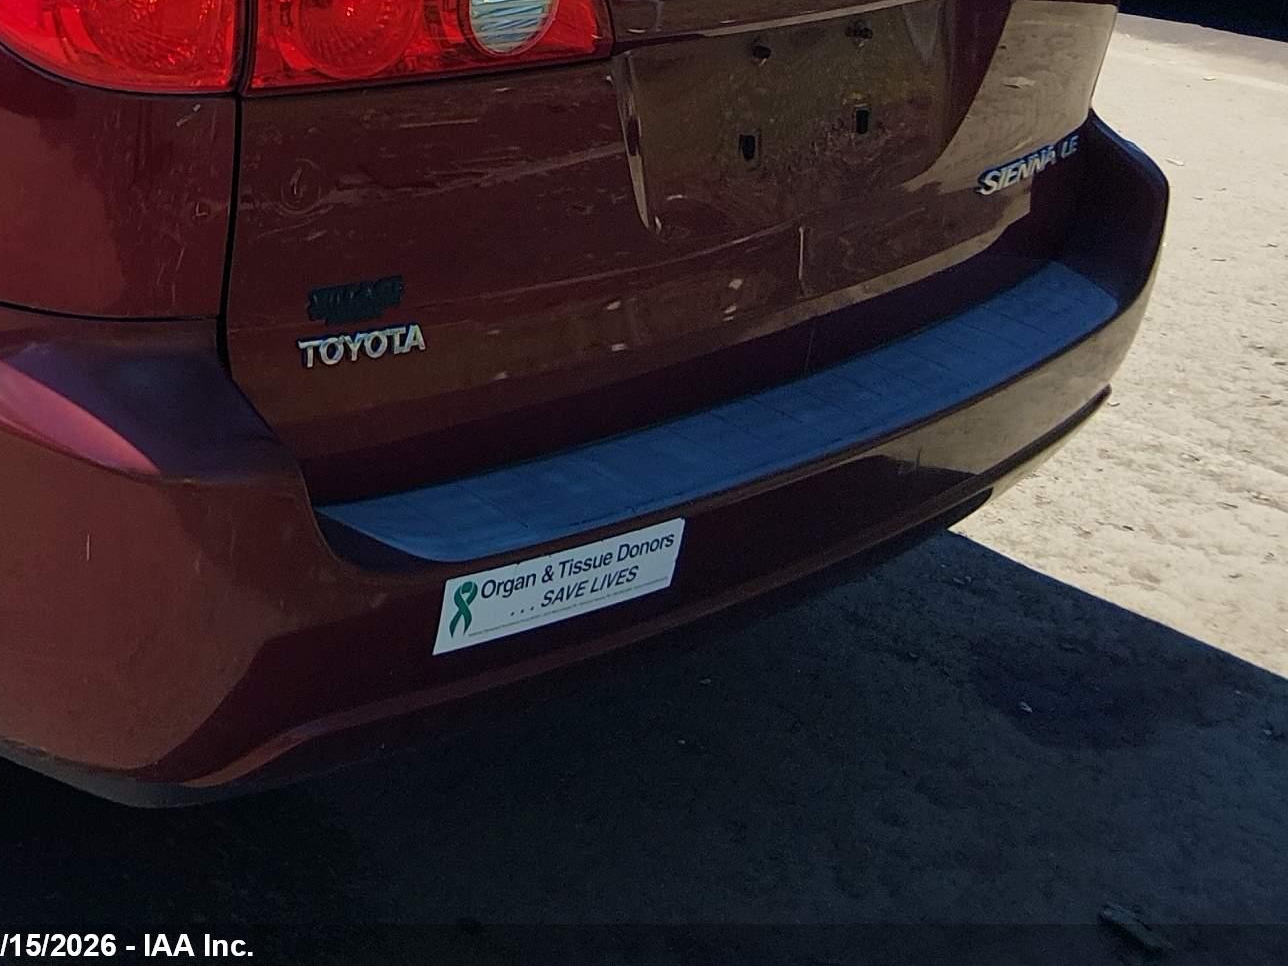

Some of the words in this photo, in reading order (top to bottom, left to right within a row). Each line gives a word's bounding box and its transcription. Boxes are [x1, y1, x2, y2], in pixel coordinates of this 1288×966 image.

[976, 145, 1056, 195] SIENNA
[1060, 135, 1079, 159] LE
[298, 323, 426, 367] TOYOTA
[480, 572, 536, 600] Organ
[541, 565, 555, 584] &
[558, 550, 613, 579] Tissue
[616, 533, 675, 562] Donors
[540, 580, 590, 608] SAVE
[590, 565, 640, 594] LIVES
